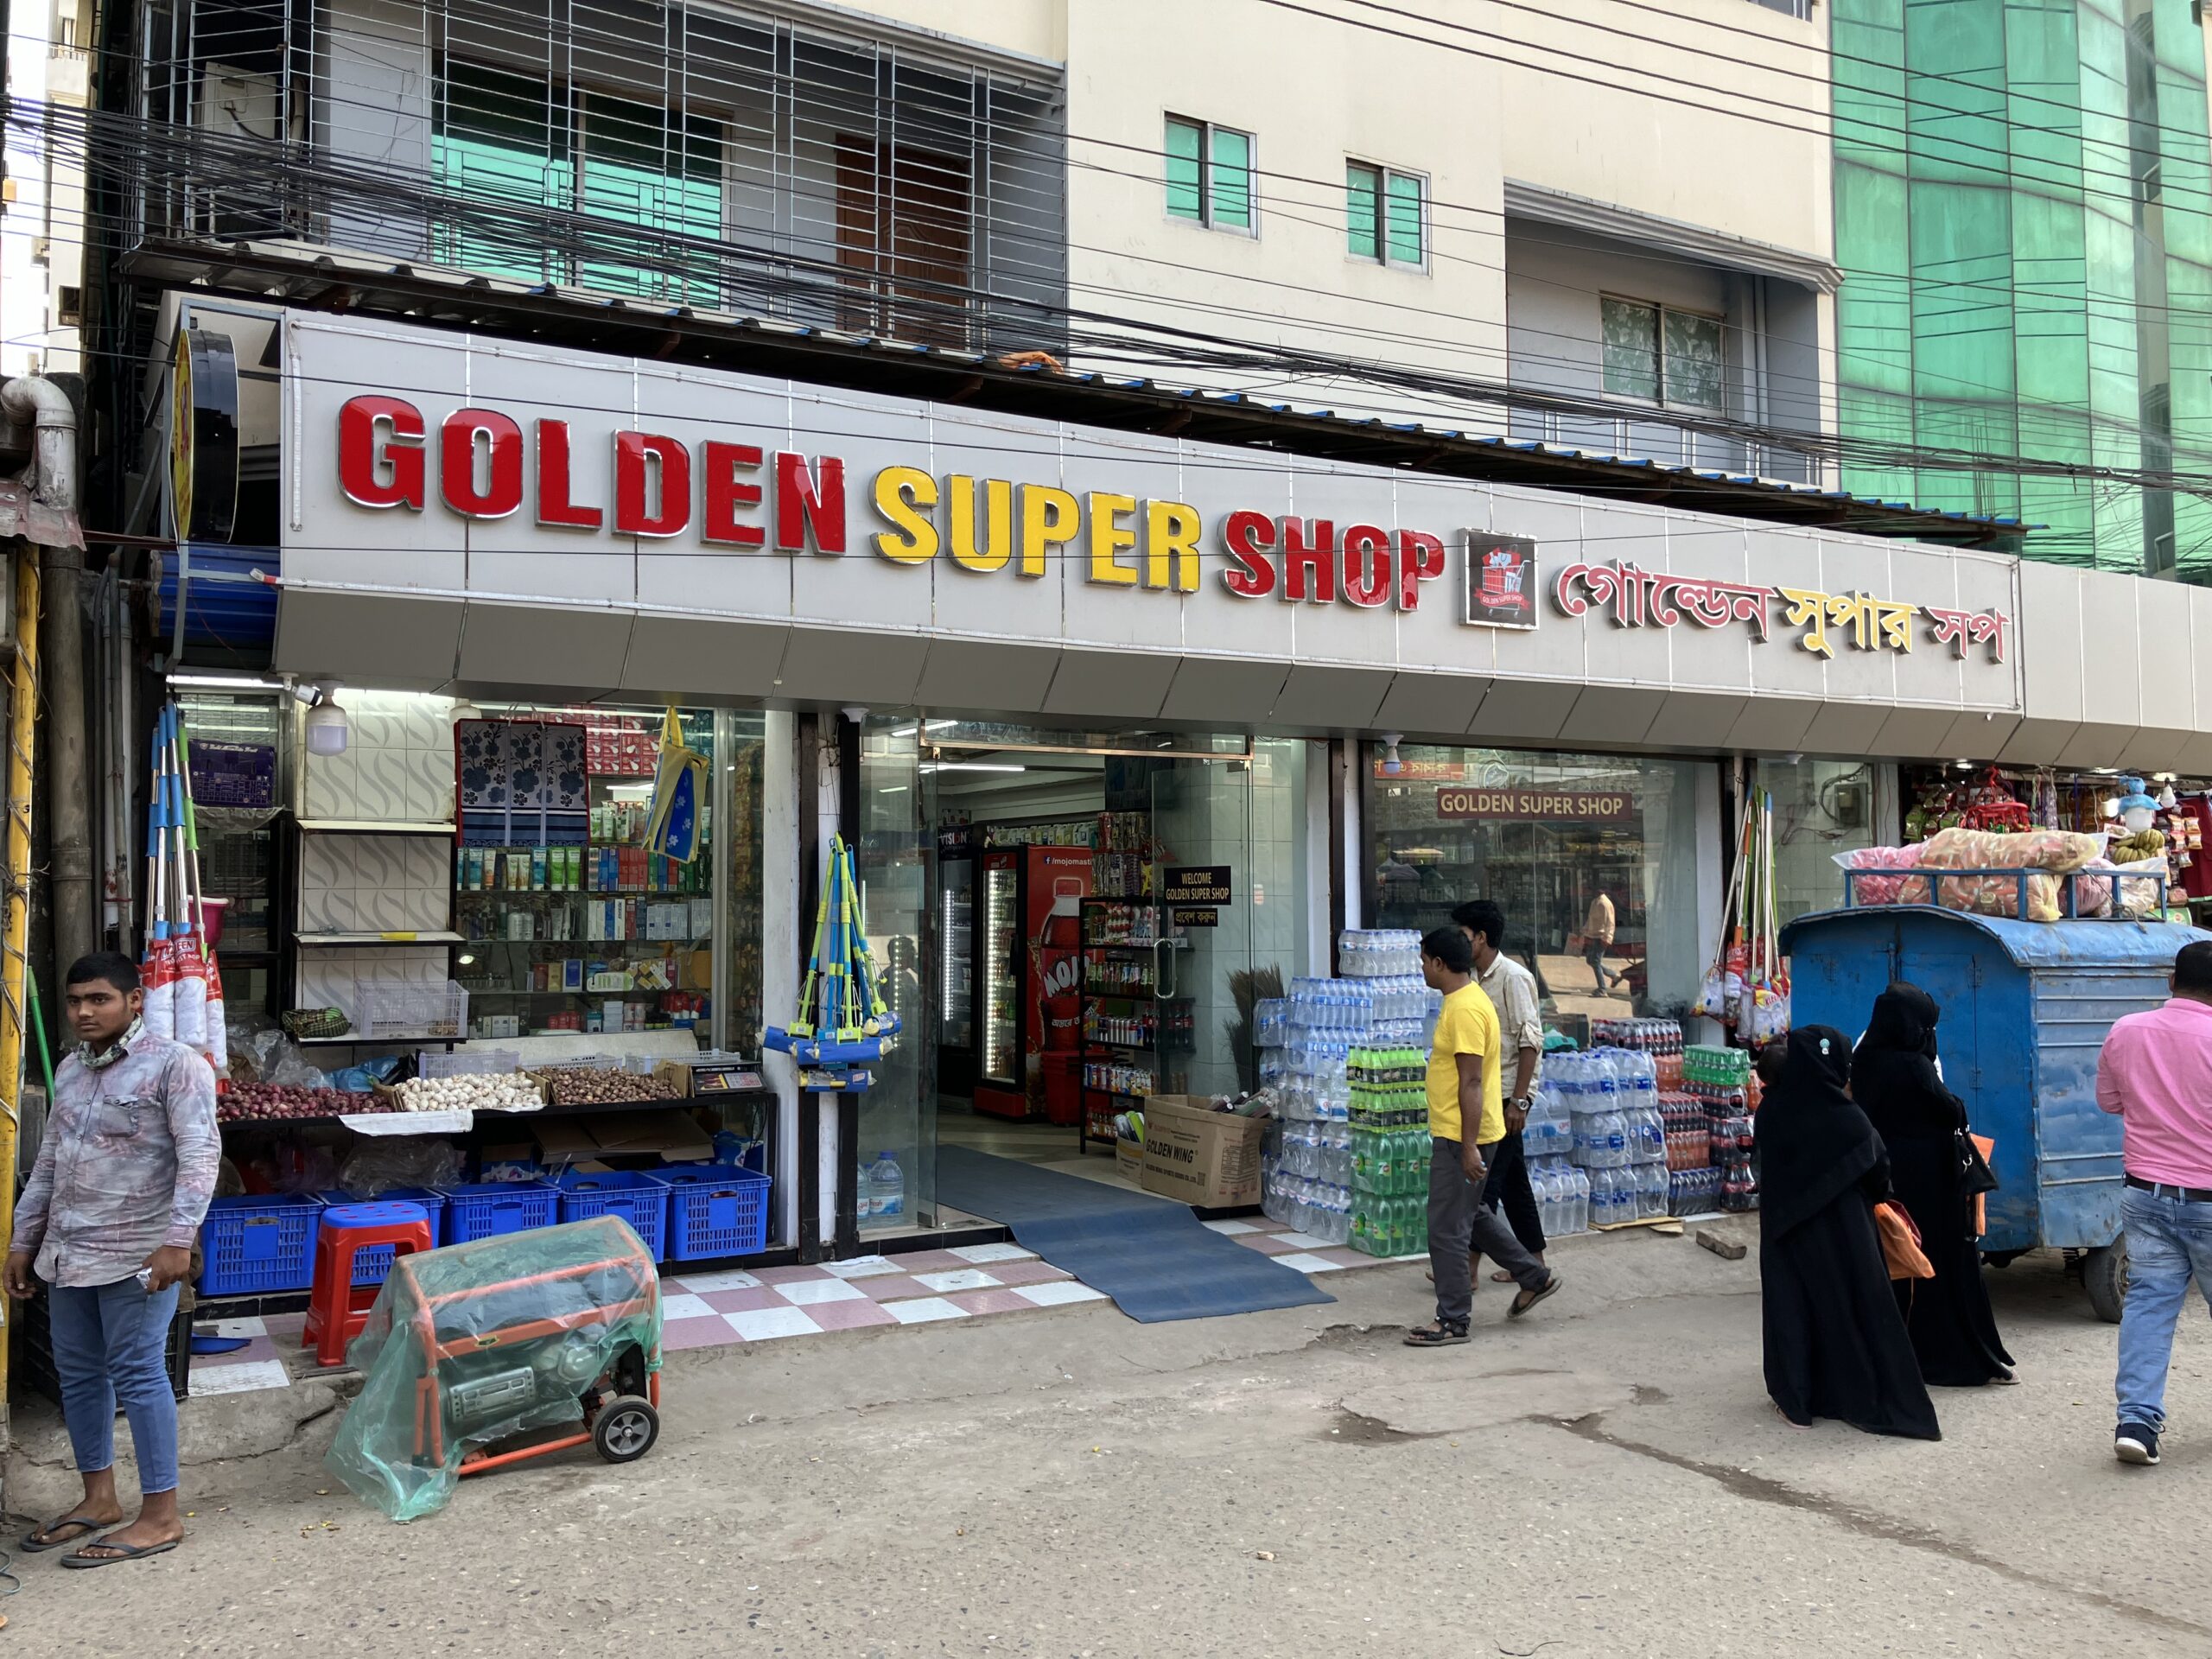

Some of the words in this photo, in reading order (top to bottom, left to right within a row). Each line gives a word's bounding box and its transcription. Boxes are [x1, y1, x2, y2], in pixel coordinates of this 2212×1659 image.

[338, 394, 847, 556] GOLDEN
[869, 465, 1201, 594] SUPER
[1217, 508, 1446, 612] SHOP
[1552, 557, 1777, 644] গোল্ডেন
[1775, 586, 1922, 660] সুপার
[1919, 605, 2012, 664] সপ
[1440, 793, 1516, 813] GOLDEN
[1520, 795, 1574, 815] SUPER
[1578, 797, 1623, 816] SHOP
[1181, 872, 1212, 885] WELCOME
[1166, 888, 1191, 900] GOLDEN
[1191, 888, 1211, 900] SUPER
[1211, 887, 1230, 899] SHOP
[1175, 912, 1194, 923] প্রবেশ
[1198, 912, 1217, 923] করুন
[1147, 1140, 1173, 1159] GOLDEN
[1173, 1147, 1194, 1163] WING
